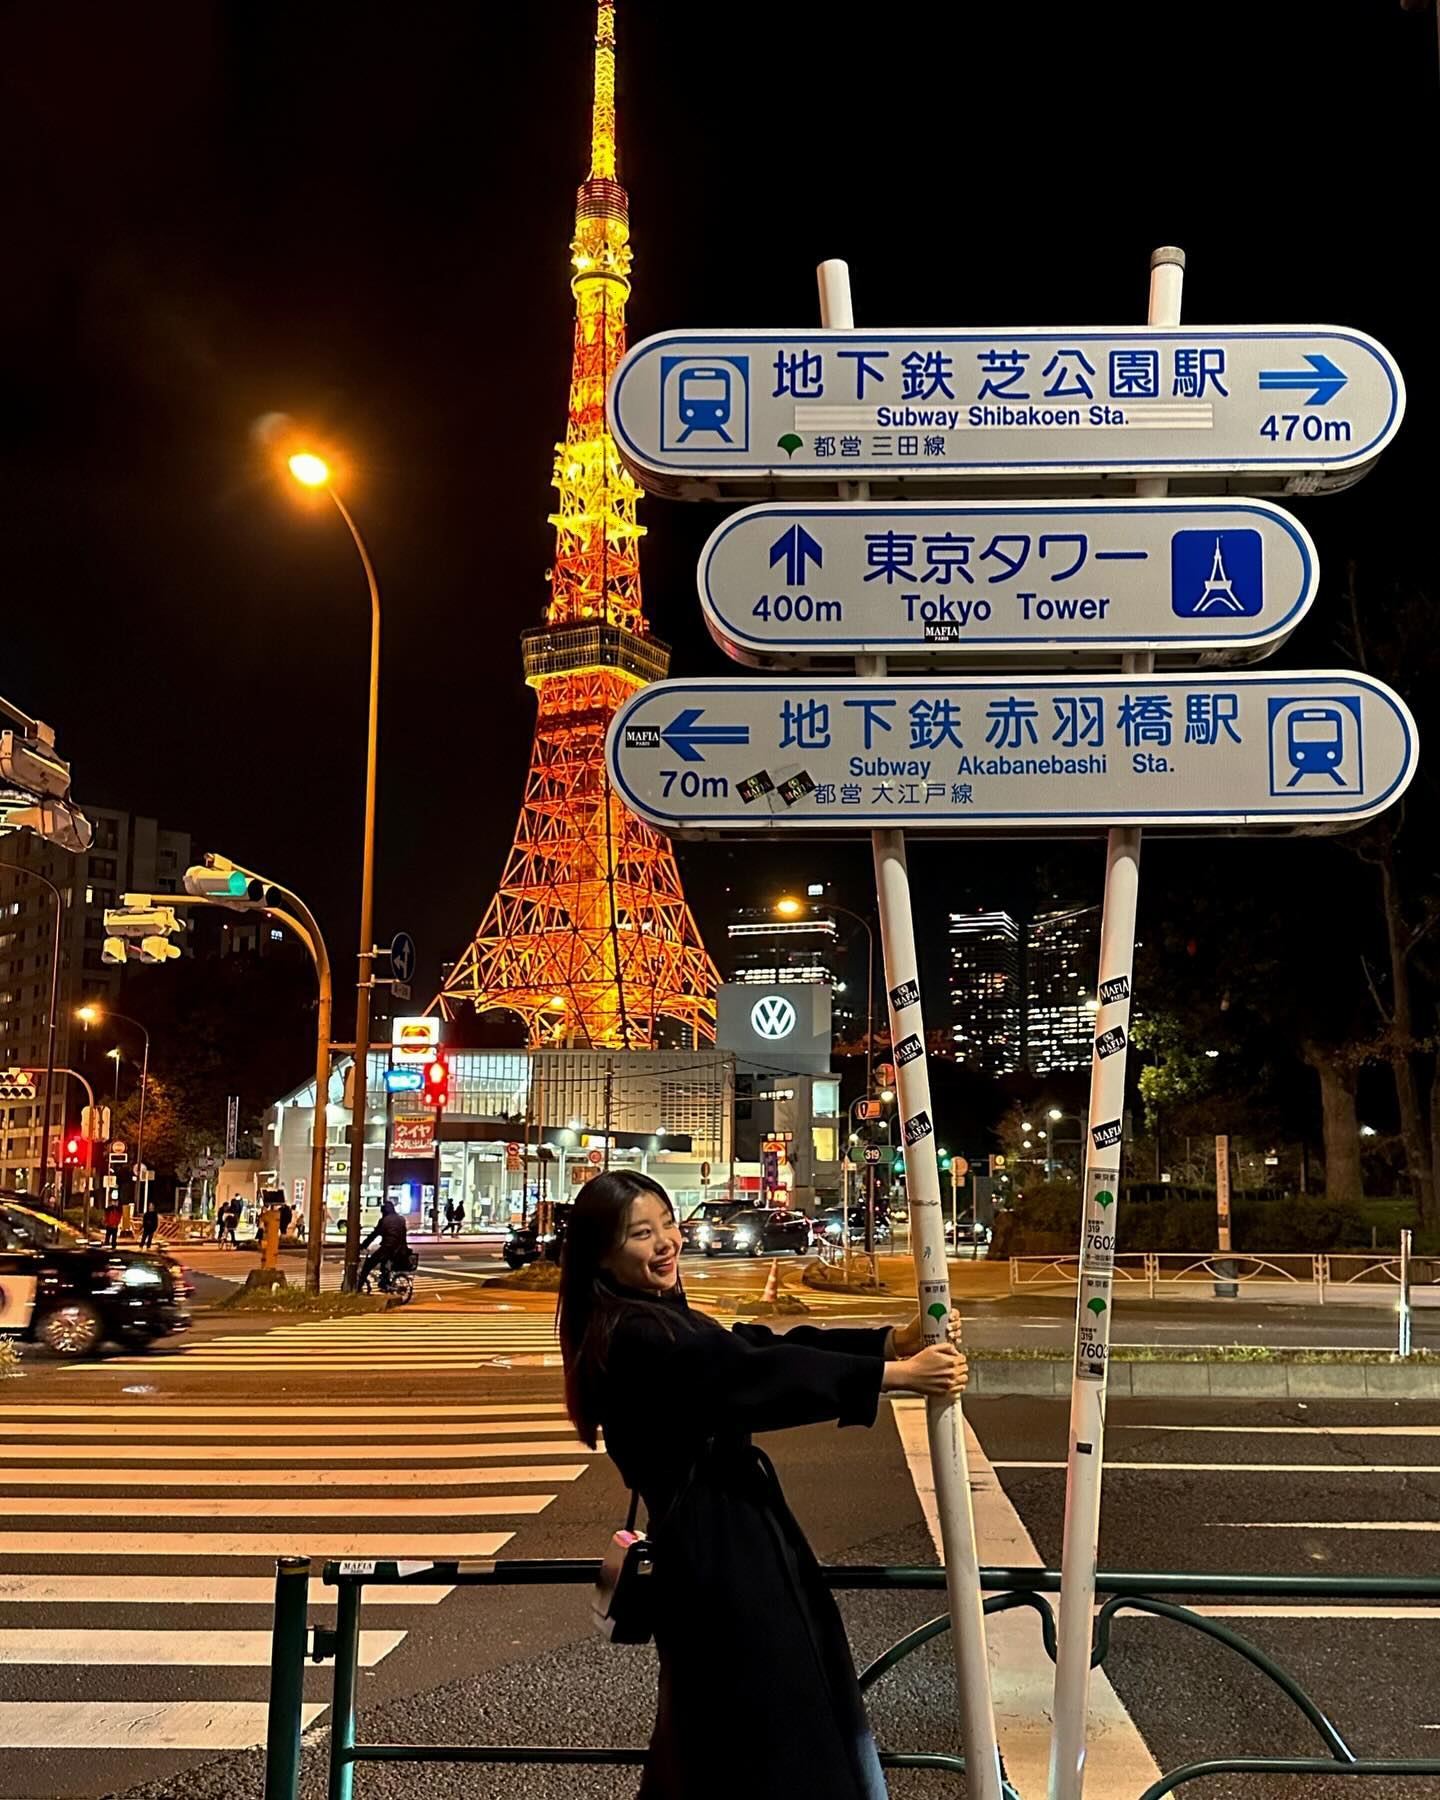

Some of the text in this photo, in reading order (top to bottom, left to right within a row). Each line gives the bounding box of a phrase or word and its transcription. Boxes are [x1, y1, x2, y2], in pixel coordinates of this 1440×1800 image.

[876, 405, 1129, 429] Subway Shibakoen Sta.
[1259, 415, 1352, 442] 470m
[863, 530, 1149, 585] 東京タワー
[752, 594, 842, 623] 400m
[900, 592, 1110, 626] Tokyo Tower
[925, 626, 958, 636] MAFIA
[626, 731, 659, 741] MAFIA
[849, 753, 1175, 780] Subway Akabanebashi Sta.
[659, 771, 729, 799] 70m
[894, 989, 919, 1007] MAFIA
[1101, 979, 1129, 1000] MAFIA
[895, 1039, 922, 1062] MAFIA
[1098, 1036, 1125, 1054] MAFIA
[397, 1124, 431, 1138] タイヤ
[905, 1121, 931, 1143] MAFIA
[1093, 1124, 1122, 1143] MAFIA
[864, 1149, 880, 1161] 319
[1087, 1235, 1116, 1251] 7602
[343, 1562, 372, 1570] MAFIA
